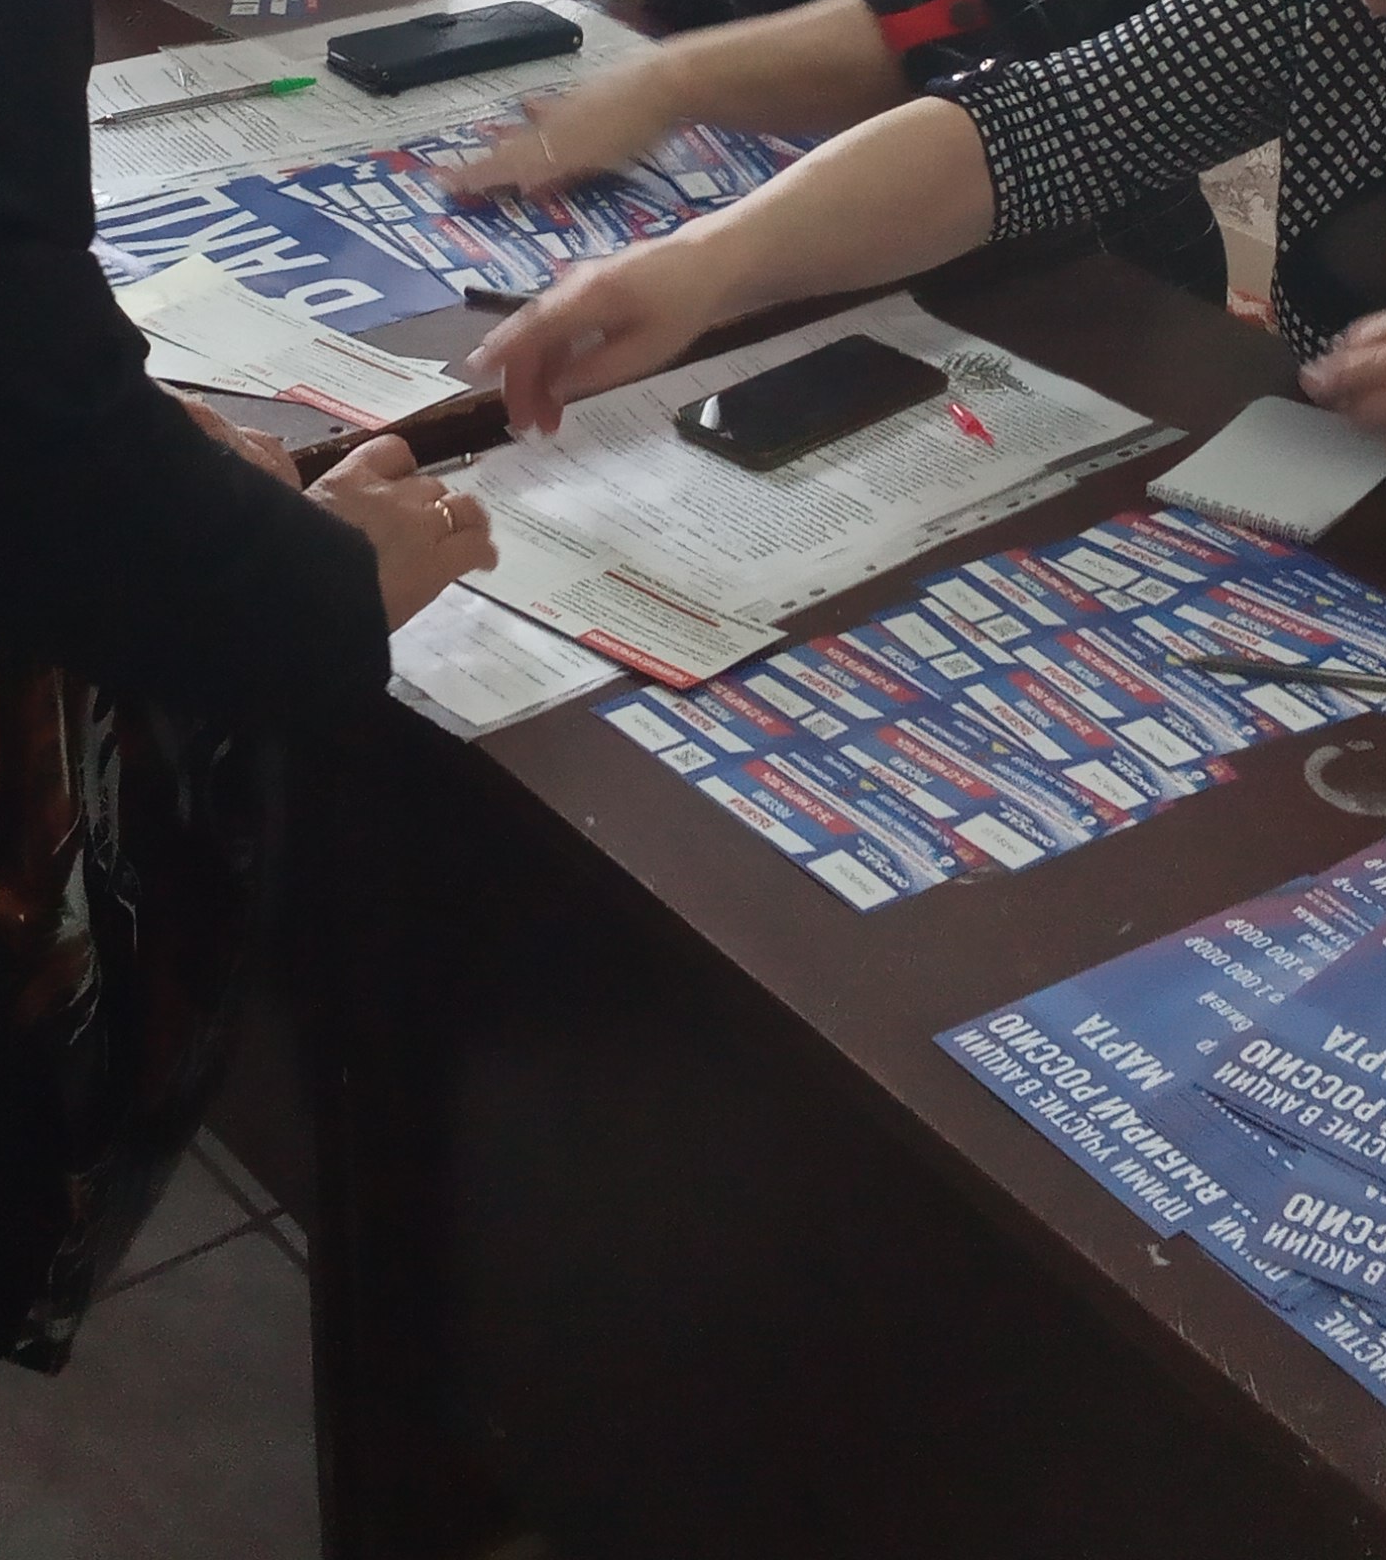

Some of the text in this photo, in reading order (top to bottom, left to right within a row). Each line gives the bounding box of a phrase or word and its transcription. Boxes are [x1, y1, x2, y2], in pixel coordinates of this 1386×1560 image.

[988, 1013, 1108, 1102] РОССИЮ
[1071, 1012, 1175, 1091] МАРТА
[1212, 1061, 1306, 1115] АКЦИИ
[953, 1028, 1194, 1223] ПРИМИ УЧАСТИЕ В АКЦИИ
[1298, 1105, 1324, 1127] В
[1262, 1222, 1365, 1275] АКЦИИ
[1362, 1260, 1386, 1286] В
